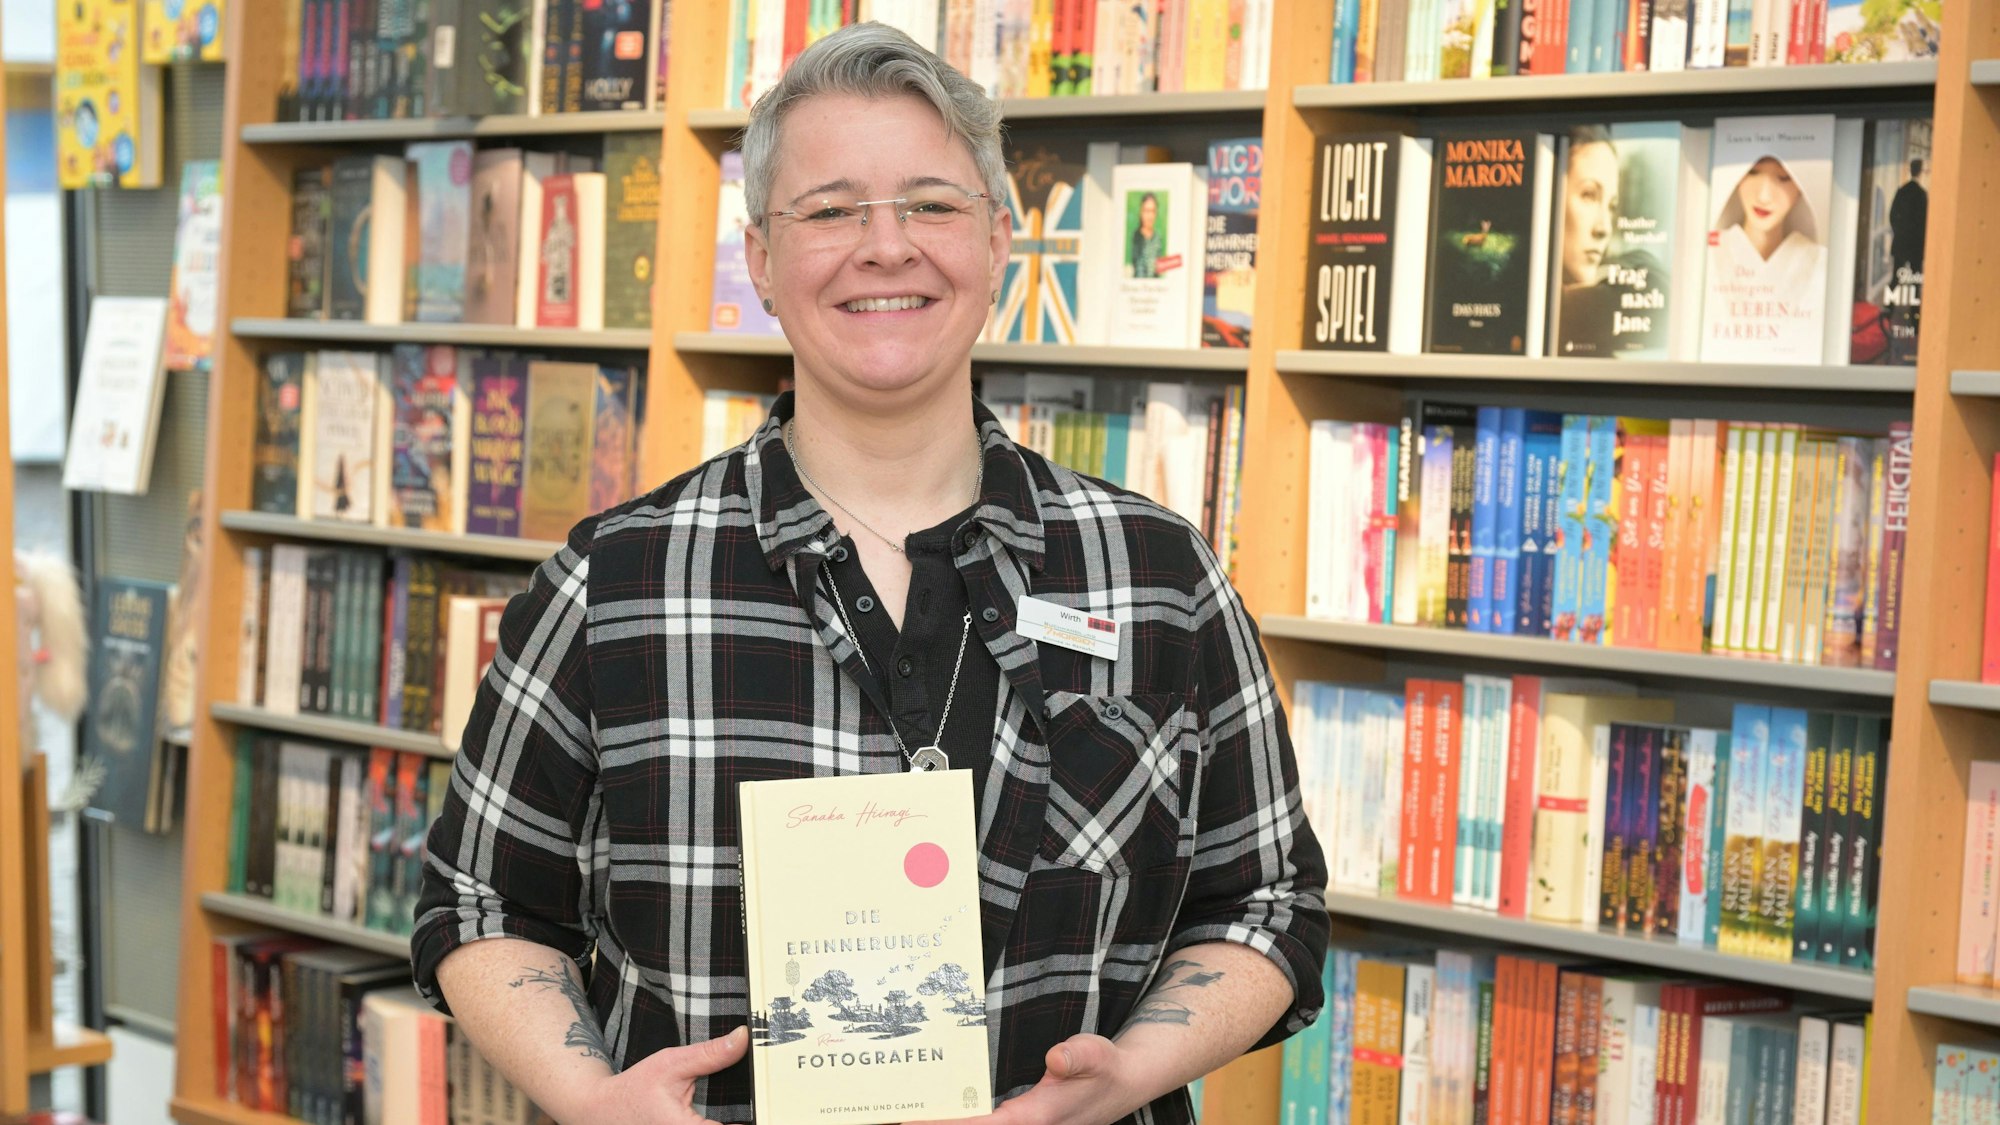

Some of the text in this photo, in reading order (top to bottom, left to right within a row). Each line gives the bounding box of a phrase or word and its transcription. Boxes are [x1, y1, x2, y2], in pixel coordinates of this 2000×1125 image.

[583, 78, 634, 101] HOLLY
[1445, 139, 1526, 164] MONIKA
[1320, 142, 1388, 222] LICHT
[1444, 163, 1525, 188] MARON
[1608, 264, 1649, 290] Frag
[1315, 264, 1377, 343] SPIEL
[1620, 288, 1665, 309] nach
[1730, 301, 1790, 319] LEBEN
[1612, 310, 1652, 337] Jane
[1712, 321, 1780, 340] FARBEN
[1891, 324, 1915, 338] TIM
[1621, 519, 1640, 548] Set
[1060, 611, 1082, 623] Wirth
[786, 801, 928, 829] Sanaka Hiiragi
[737, 853, 746, 935] FOTOGRAFEN
[1725, 851, 1741, 911] SUSAN
[1737, 842, 1755, 922] MALLERY
[1760, 855, 1777, 916] SUSAN
[1774, 847, 1792, 928] MALLERY
[1802, 865, 1815, 910] Michelle
[1826, 867, 1840, 912] Michelle
[1850, 870, 1864, 917] Michelle
[845, 909, 881, 925] DIE
[787, 932, 943, 955] ERINNERUNGS
[817, 1033, 846, 1046] Roman
[797, 1047, 944, 1069] FOTOGRAFEN
[820, 1105, 870, 1114] HOFFMANN
[895, 1102, 925, 1110] CAMPE
